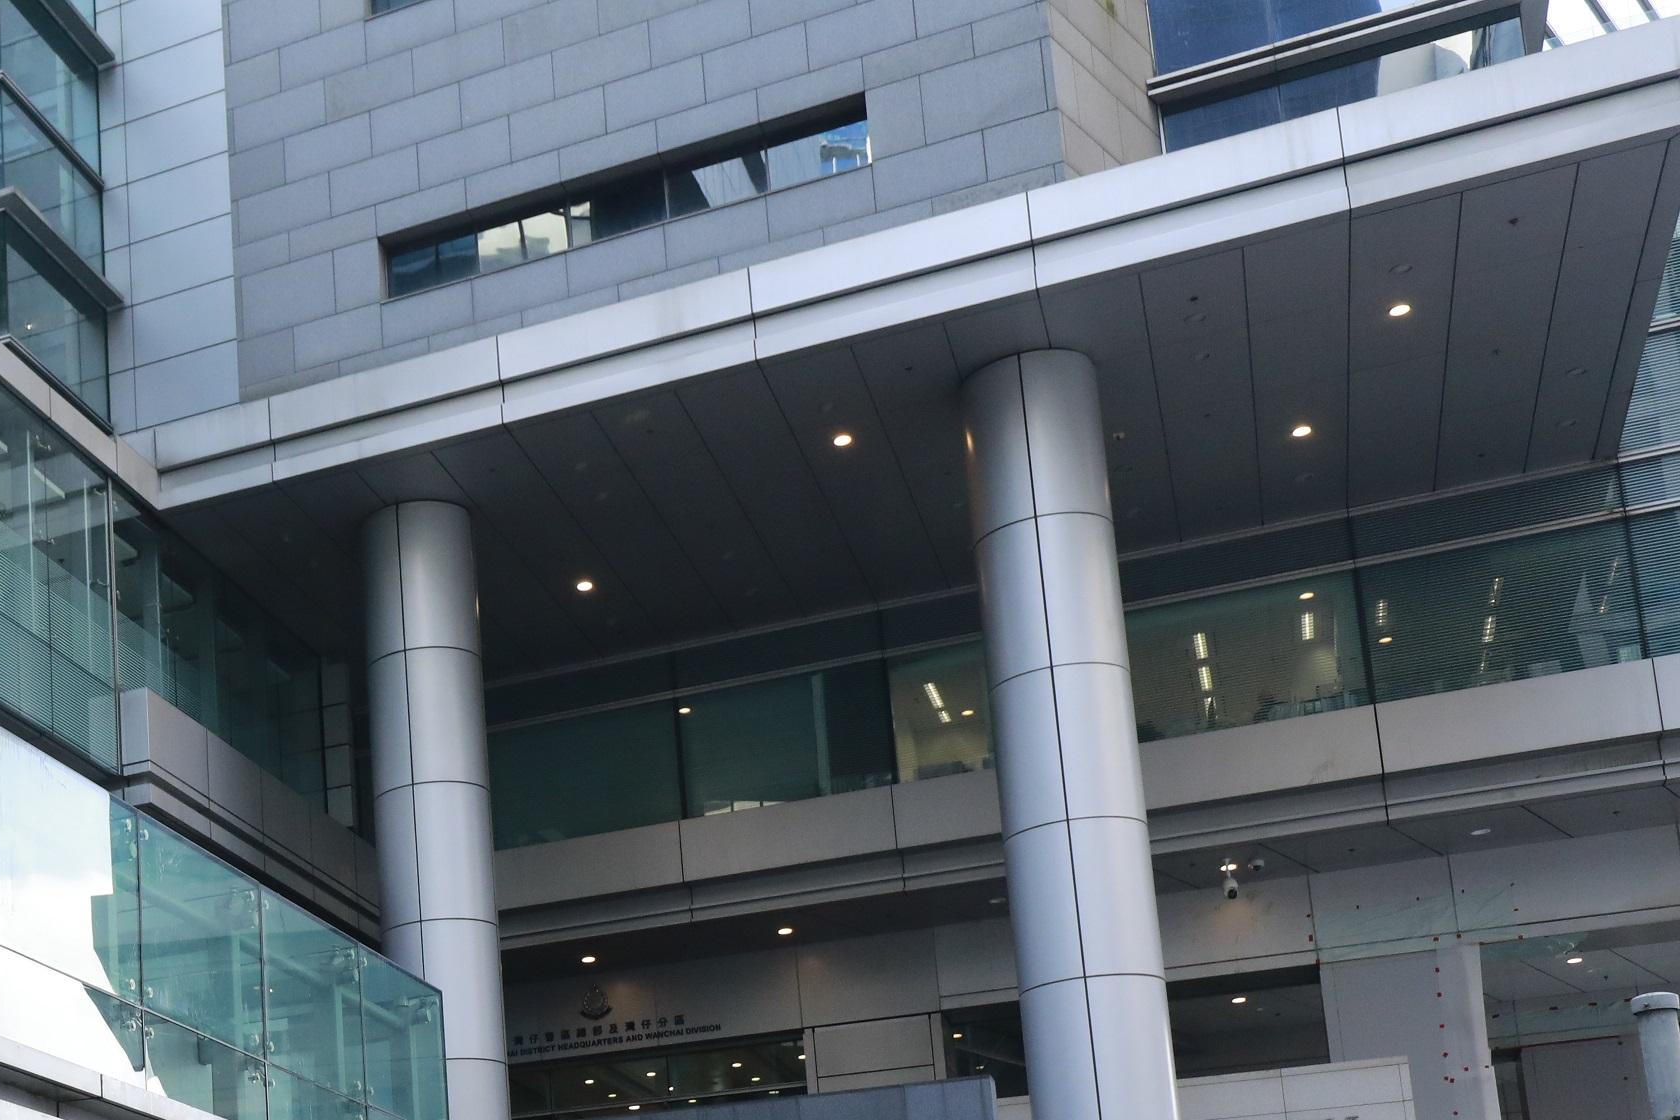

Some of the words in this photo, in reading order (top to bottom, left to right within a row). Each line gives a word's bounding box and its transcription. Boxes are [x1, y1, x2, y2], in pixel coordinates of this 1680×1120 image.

[558, 1037, 624, 1052] HEADQUARTERS
[626, 1033, 644, 1044] AND
[685, 1023, 722, 1036] DIVISION
